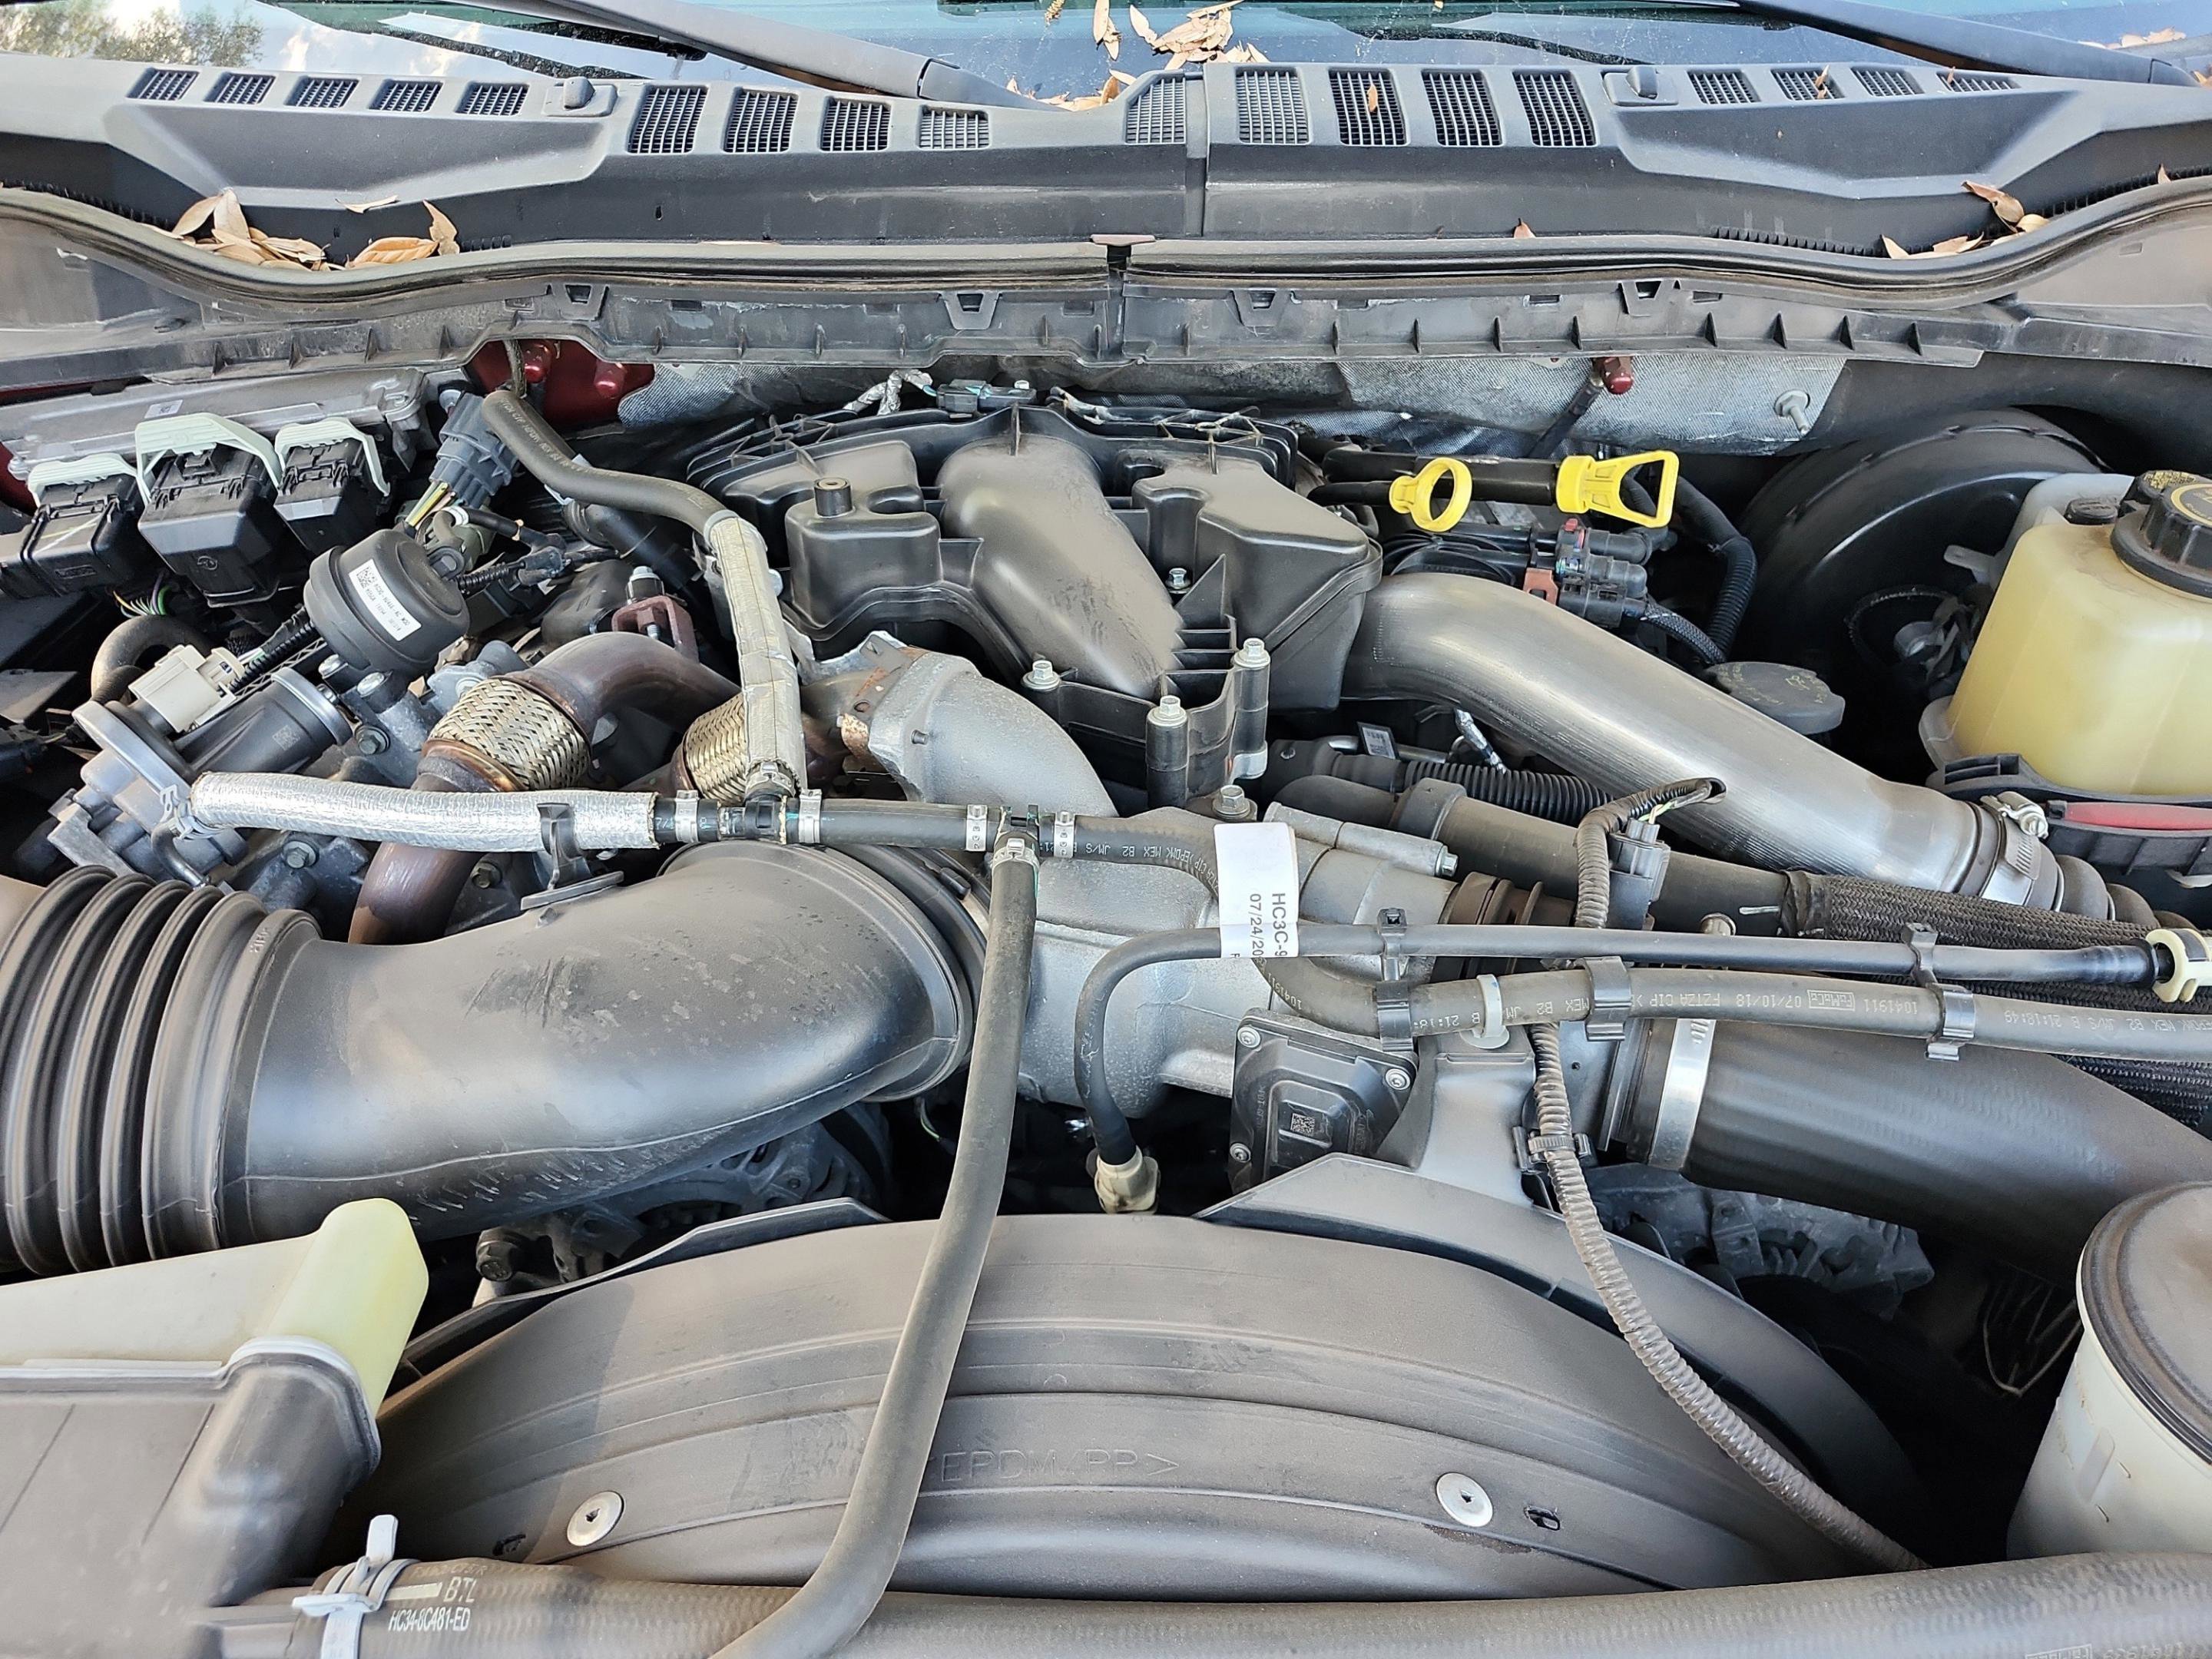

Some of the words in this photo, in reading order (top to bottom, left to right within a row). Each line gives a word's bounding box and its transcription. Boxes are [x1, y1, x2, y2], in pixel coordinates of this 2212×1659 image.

[1085, 843, 1111, 855] JM/S
[1122, 846, 1135, 856] B2
[1143, 846, 1162, 857] MEX
[1536, 1000, 1553, 1015] B2
[1565, 997, 1590, 1012] MEX
[1650, 993, 1674, 1007] CIP
[1735, 993, 1803, 1008] 07/10/18
[1809, 991, 1854, 1009] FoMoCo
[1863, 998, 1919, 1015] 1041911
